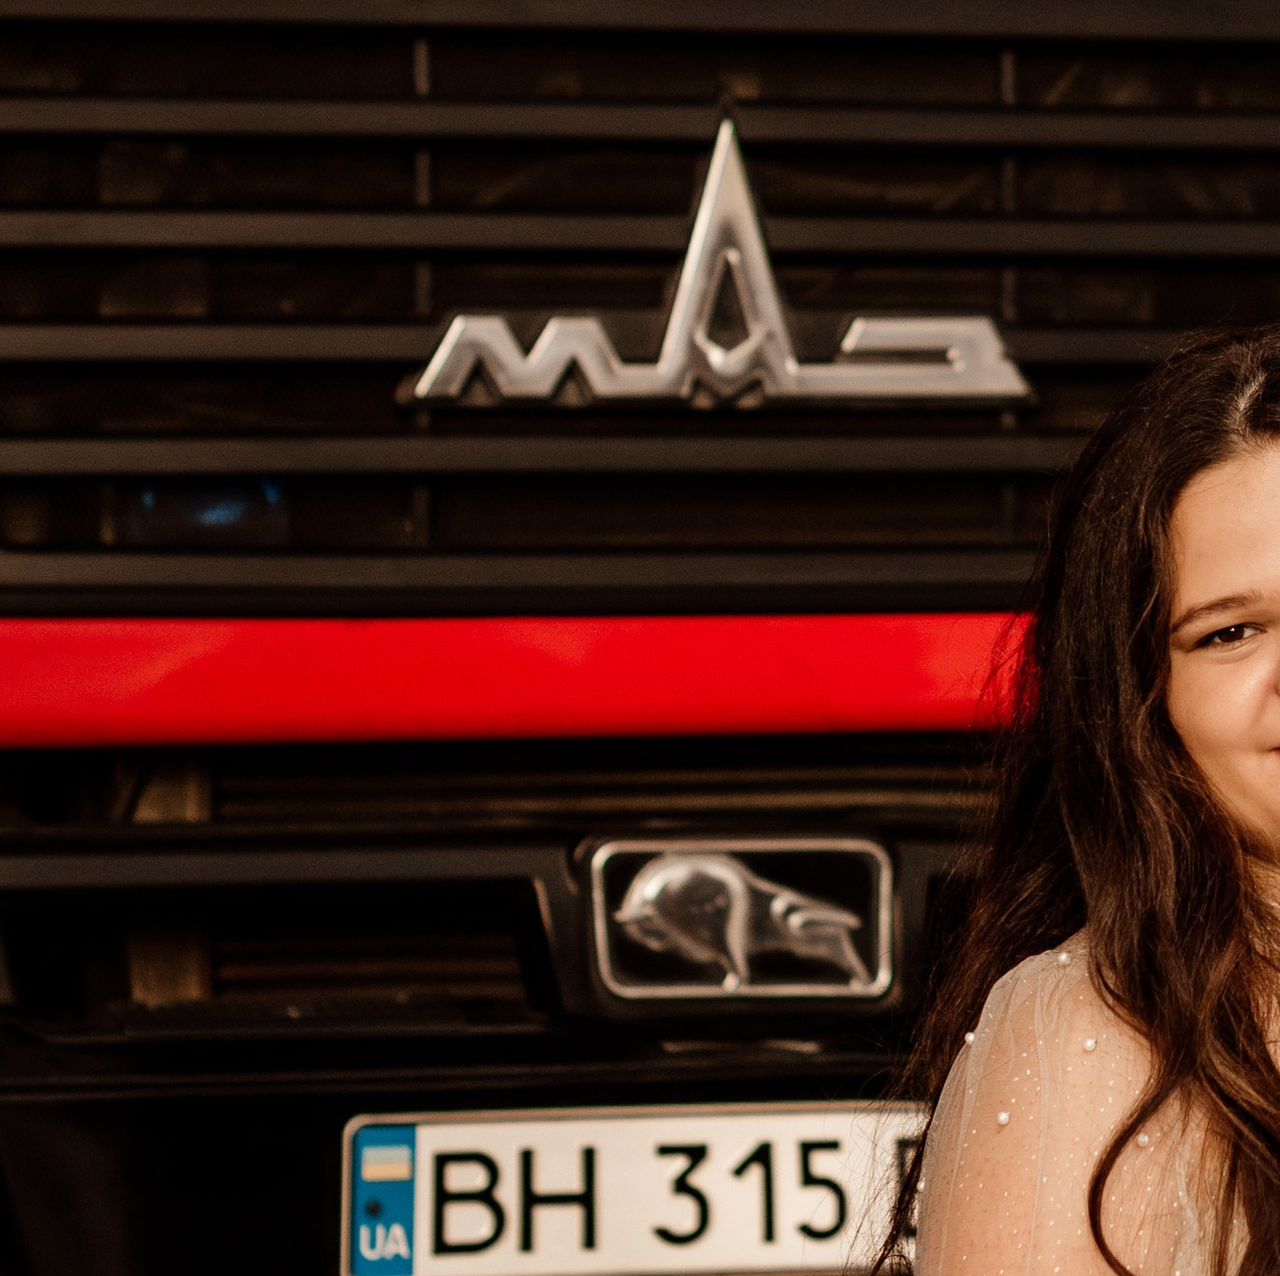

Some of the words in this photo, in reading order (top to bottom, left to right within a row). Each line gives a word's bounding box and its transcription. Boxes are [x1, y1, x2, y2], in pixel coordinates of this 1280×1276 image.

[432, 1145, 598, 1257] BH
[652, 1138, 849, 1245] 315
[358, 1222, 411, 1262] UA
